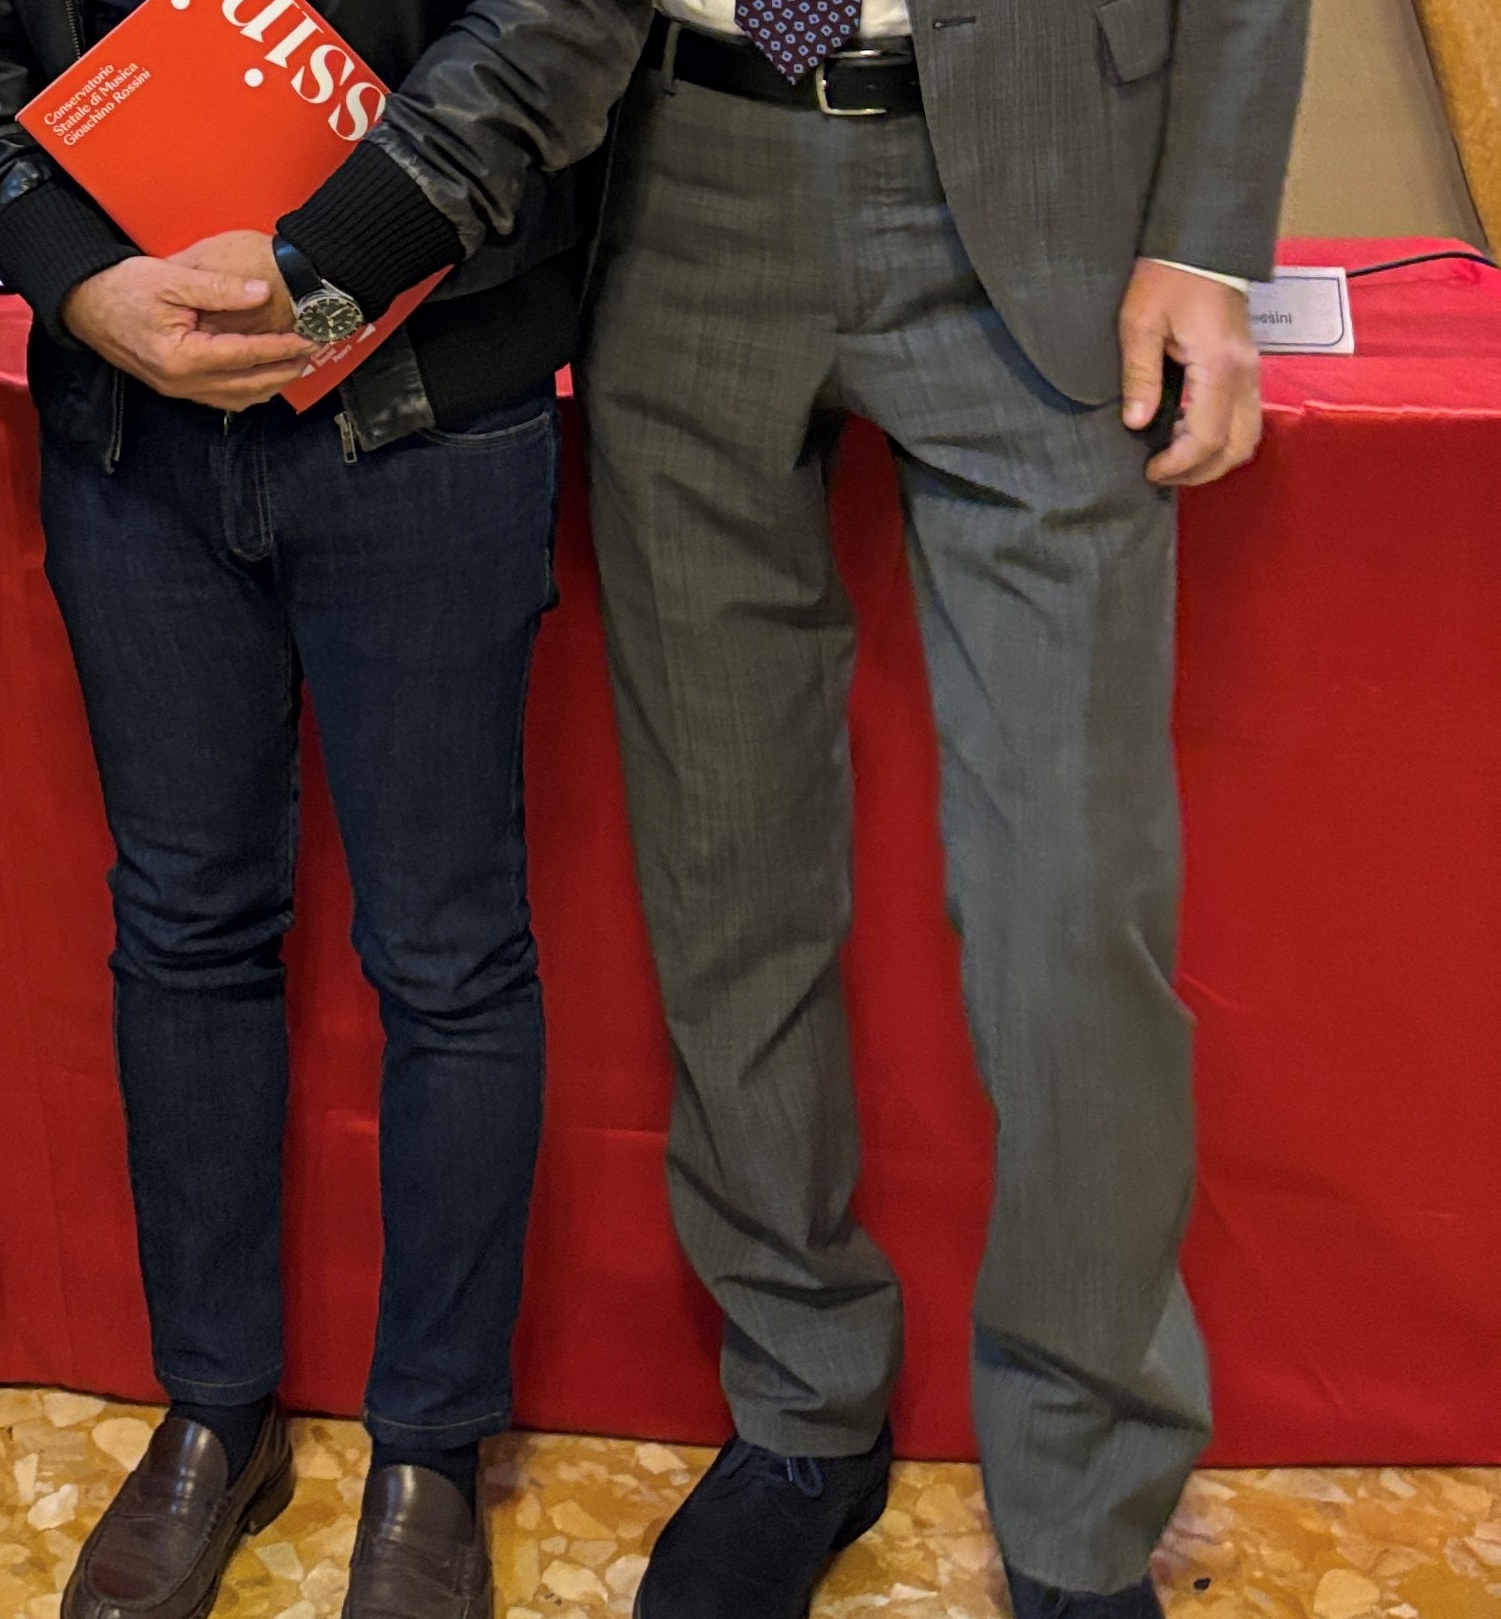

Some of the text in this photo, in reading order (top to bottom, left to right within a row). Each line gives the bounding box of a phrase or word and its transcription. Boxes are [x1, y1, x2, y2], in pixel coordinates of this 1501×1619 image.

[44, 65, 114, 125] Conservatorio
[53, 63, 138, 136] Statale di Musica
[63, 67, 151, 145] Gioachino Rossini
